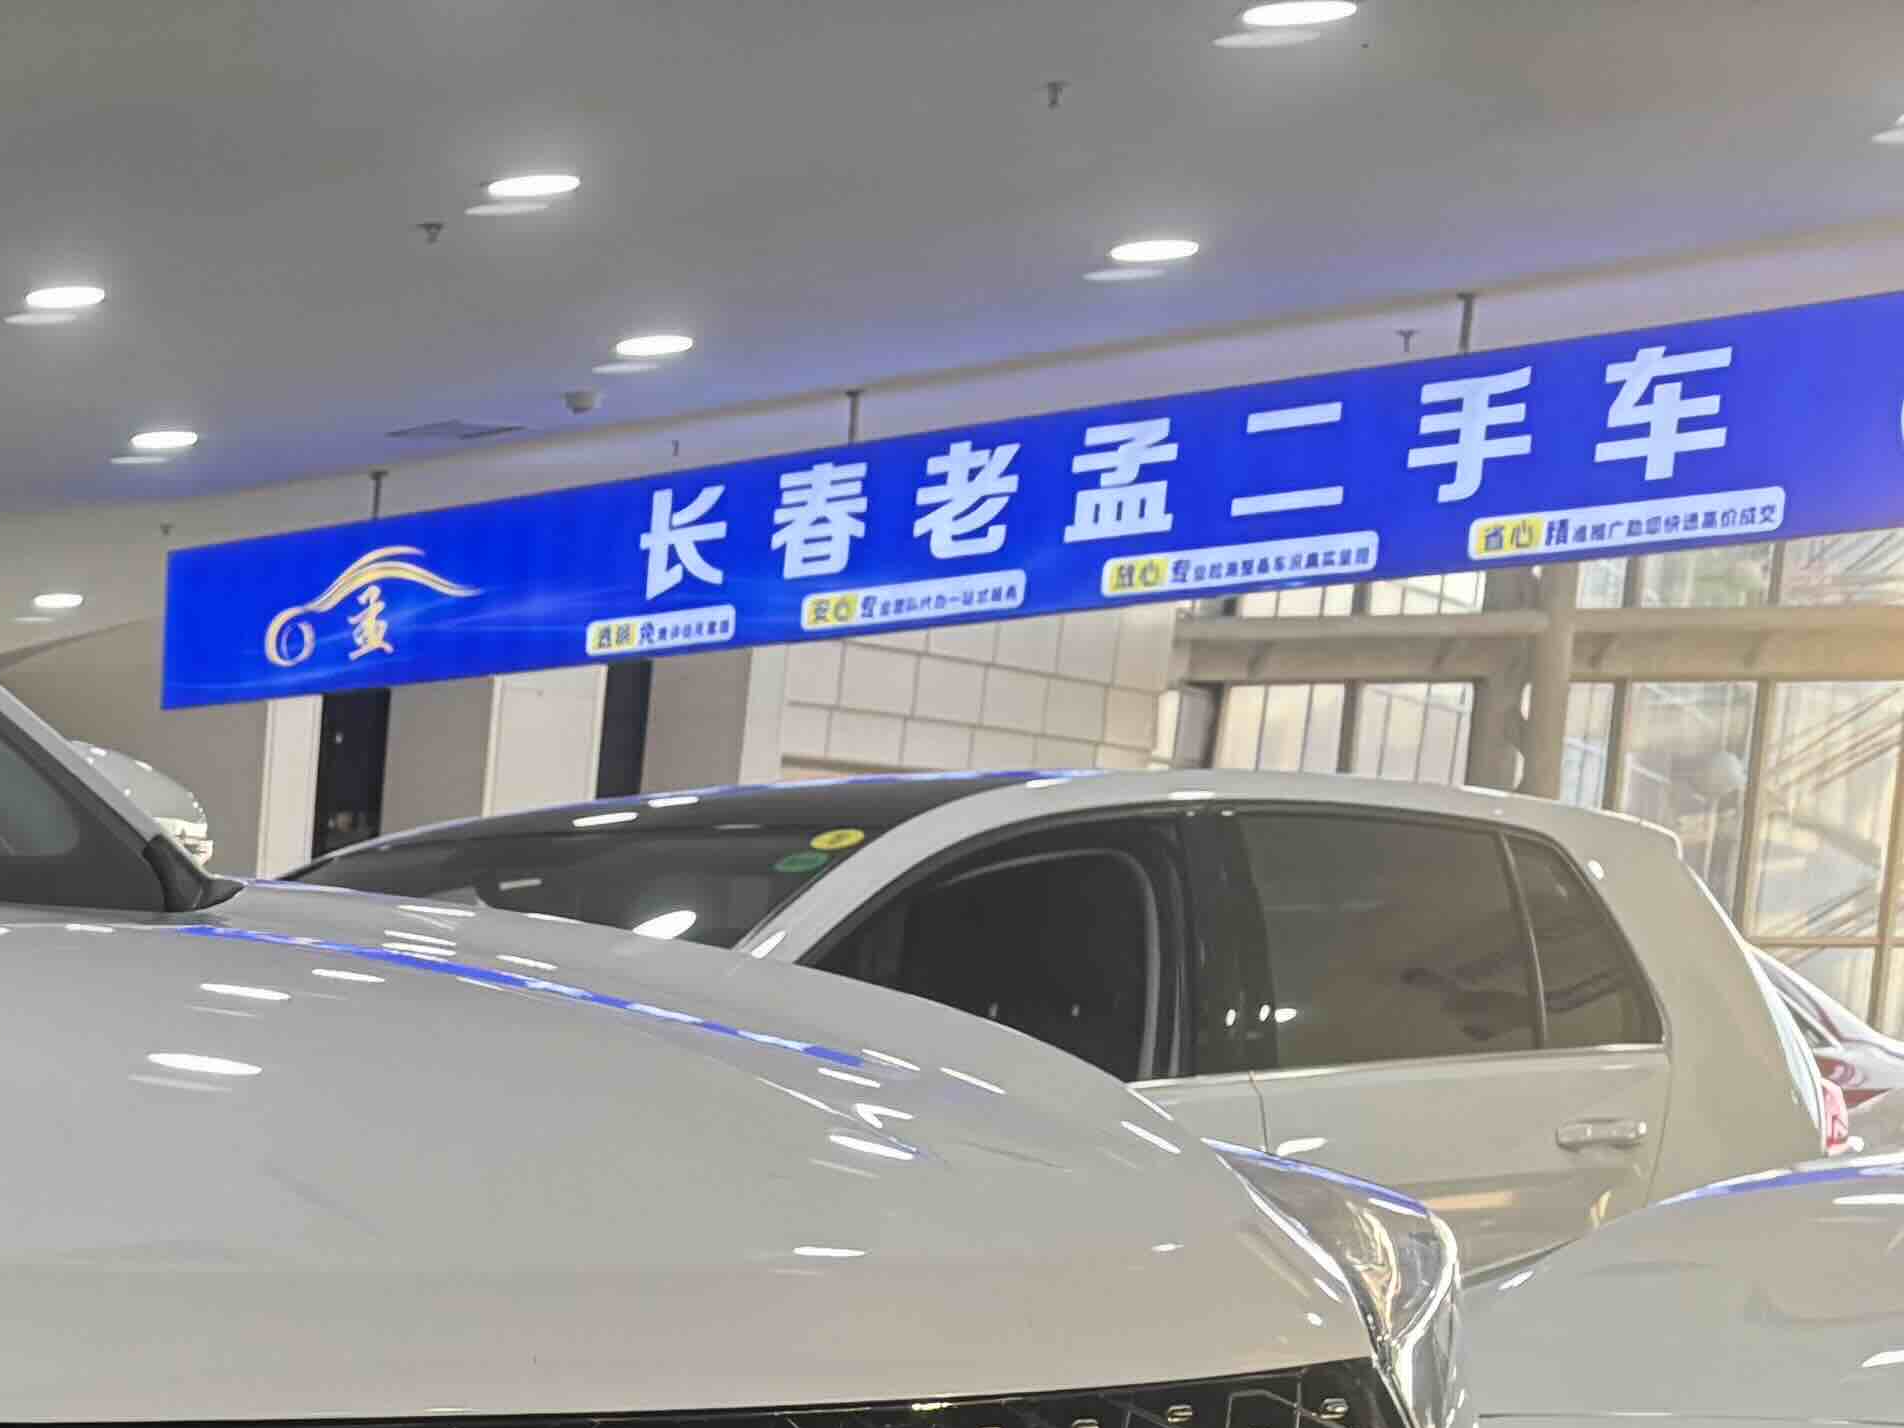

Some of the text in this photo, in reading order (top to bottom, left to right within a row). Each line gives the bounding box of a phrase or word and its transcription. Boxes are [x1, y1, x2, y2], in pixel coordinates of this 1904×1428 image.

[641, 345, 1733, 599] 长春老孟二手车
[1484, 519, 1534, 550] 省心
